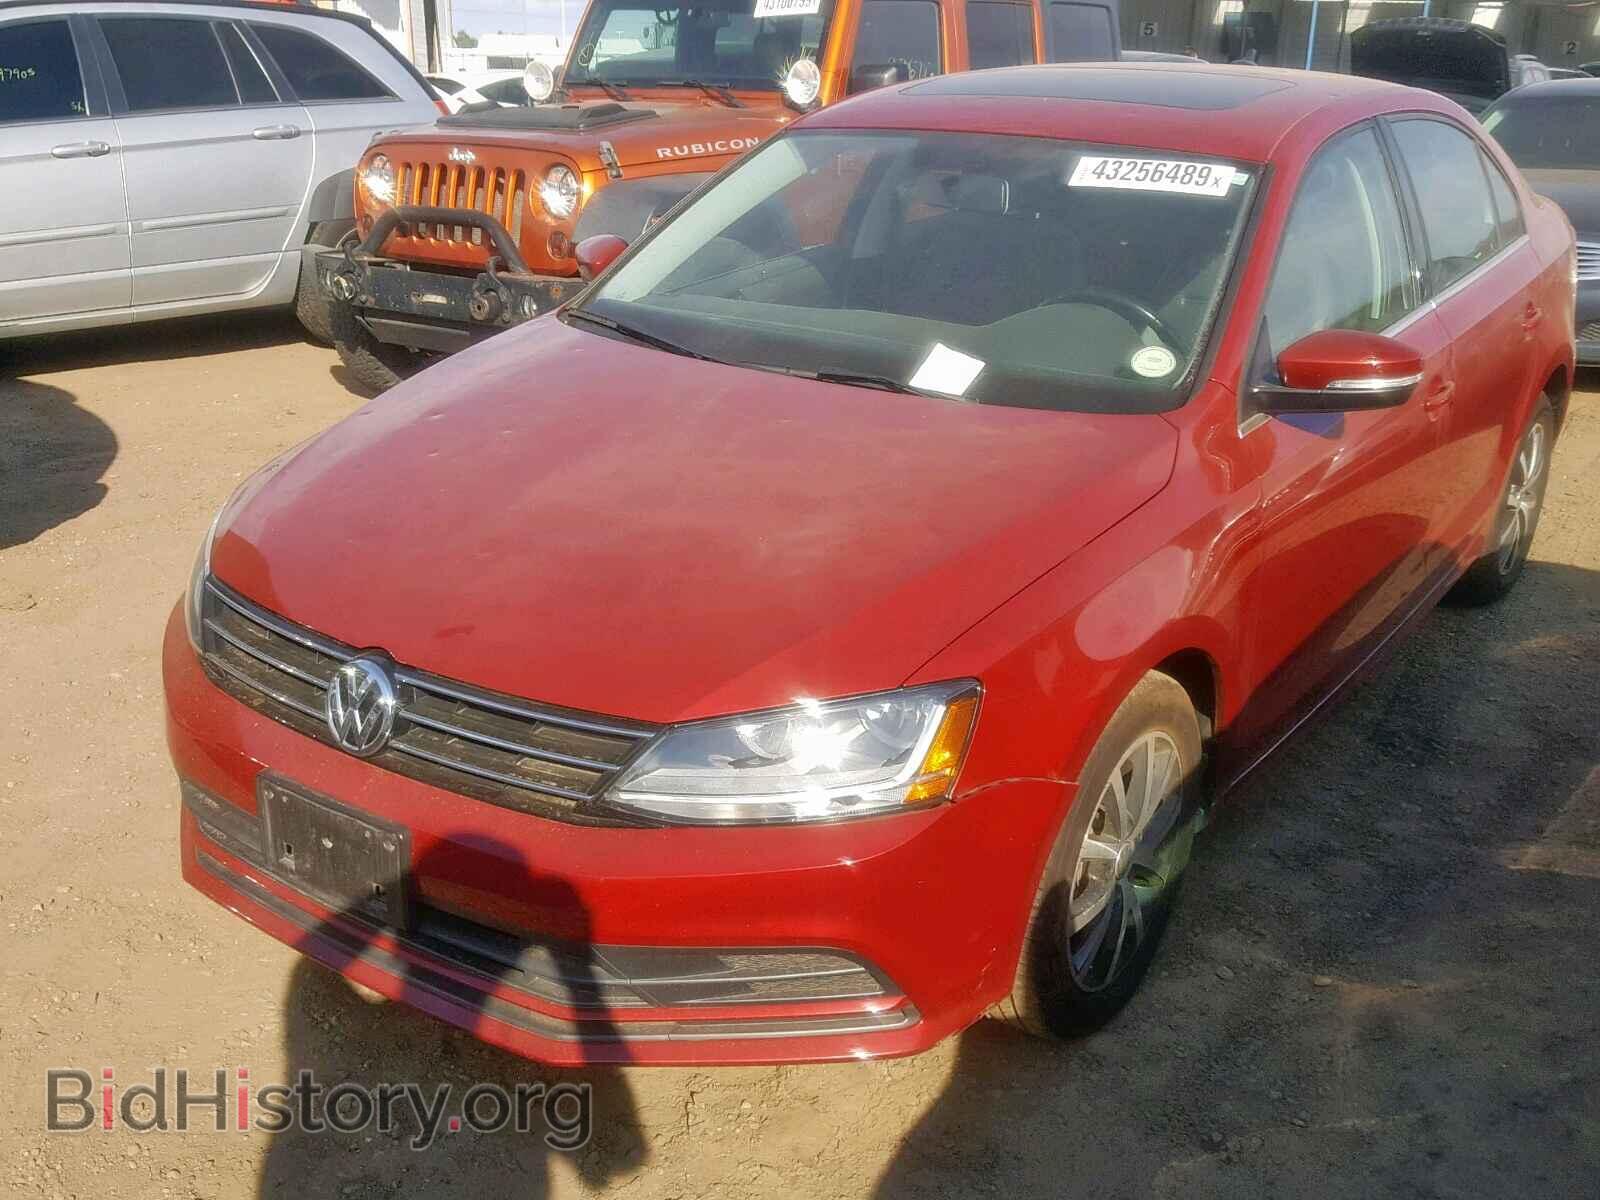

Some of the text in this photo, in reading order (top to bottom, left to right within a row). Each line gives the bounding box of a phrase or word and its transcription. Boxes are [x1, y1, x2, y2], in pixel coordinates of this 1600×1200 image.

[1143, 22, 1155, 36] 5
[1566, 41, 1577, 55] 2
[656, 137, 759, 158] RUBICON
[1091, 159, 1213, 187] 43256489
